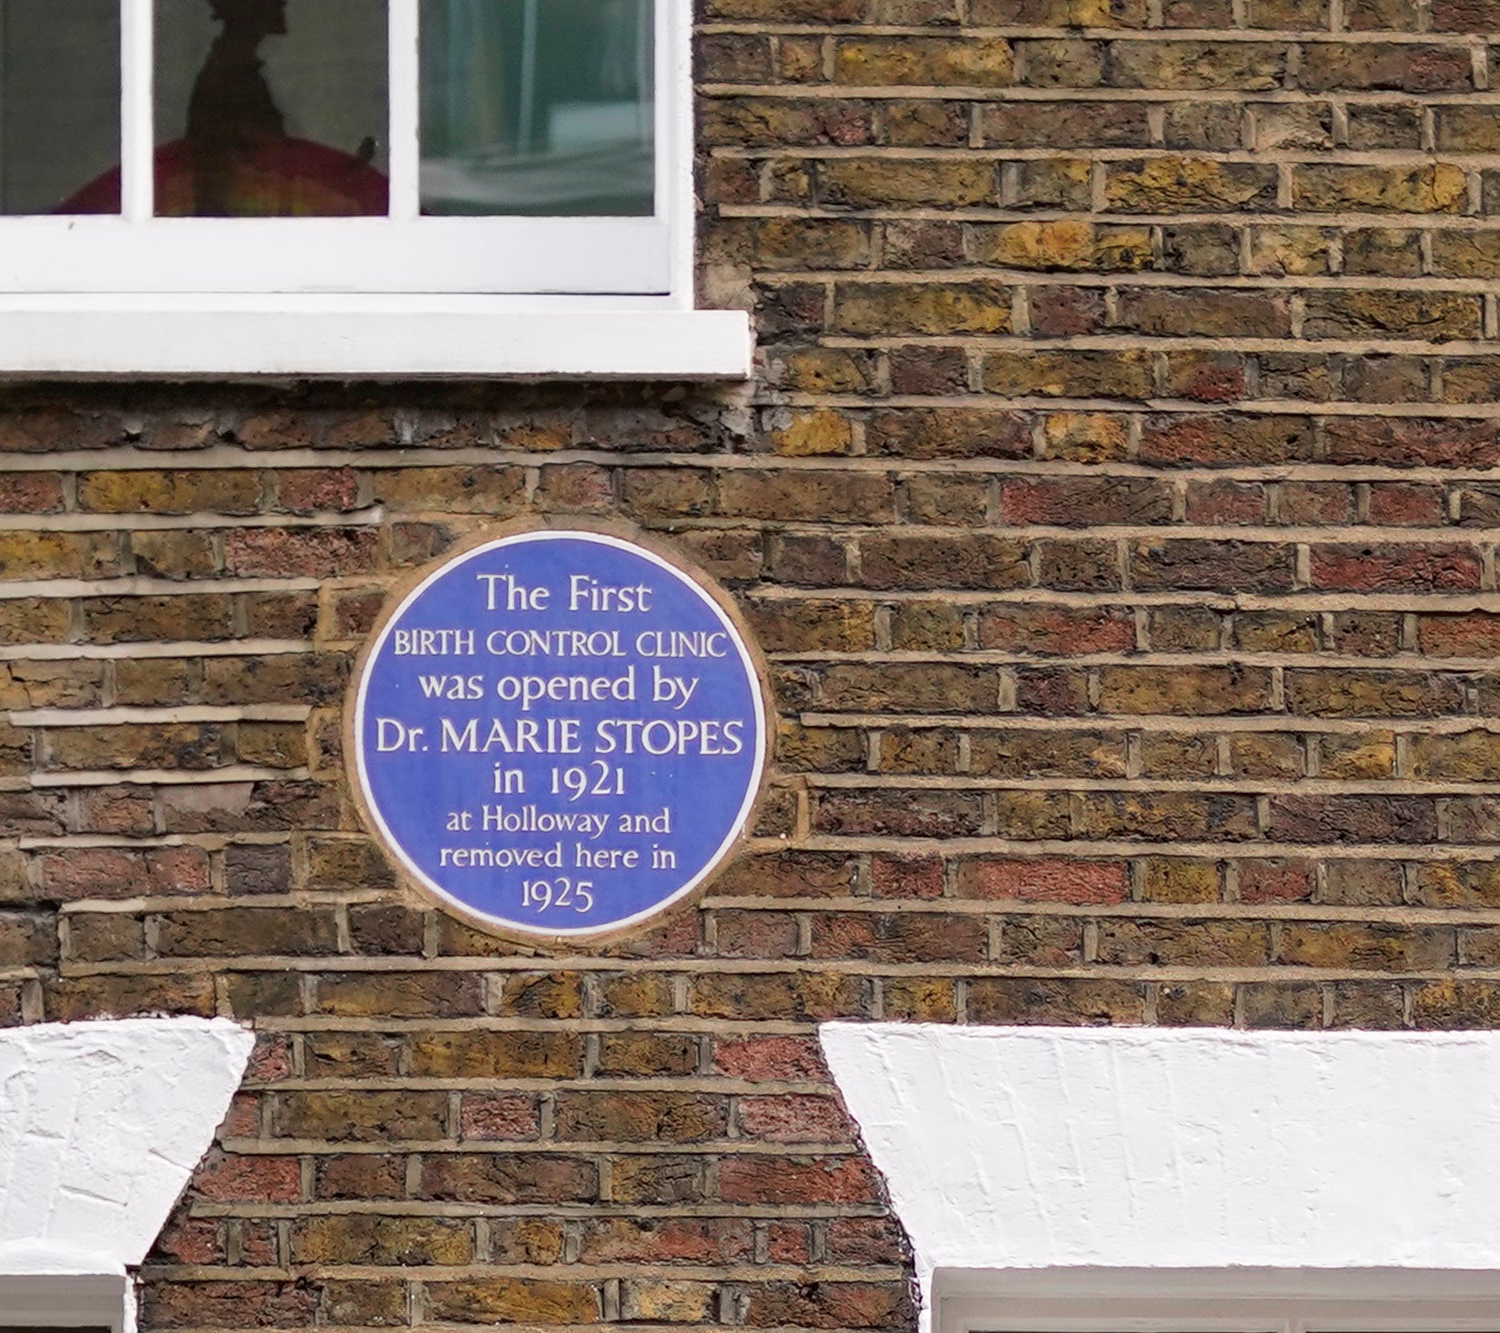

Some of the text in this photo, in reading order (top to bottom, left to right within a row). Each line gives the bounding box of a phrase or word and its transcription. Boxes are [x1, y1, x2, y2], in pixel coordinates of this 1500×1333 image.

[477, 574, 652, 613] The First
[394, 630, 727, 658] BIRTH CONTROL CLINIC
[418, 666, 699, 710] was opened by
[376, 719, 743, 755] Dr. MARIE STOPES
[493, 761, 625, 801] in 1921
[446, 805, 670, 840] at Holloway and
[440, 842, 676, 869] removed here in
[521, 880, 594, 912] 1925
